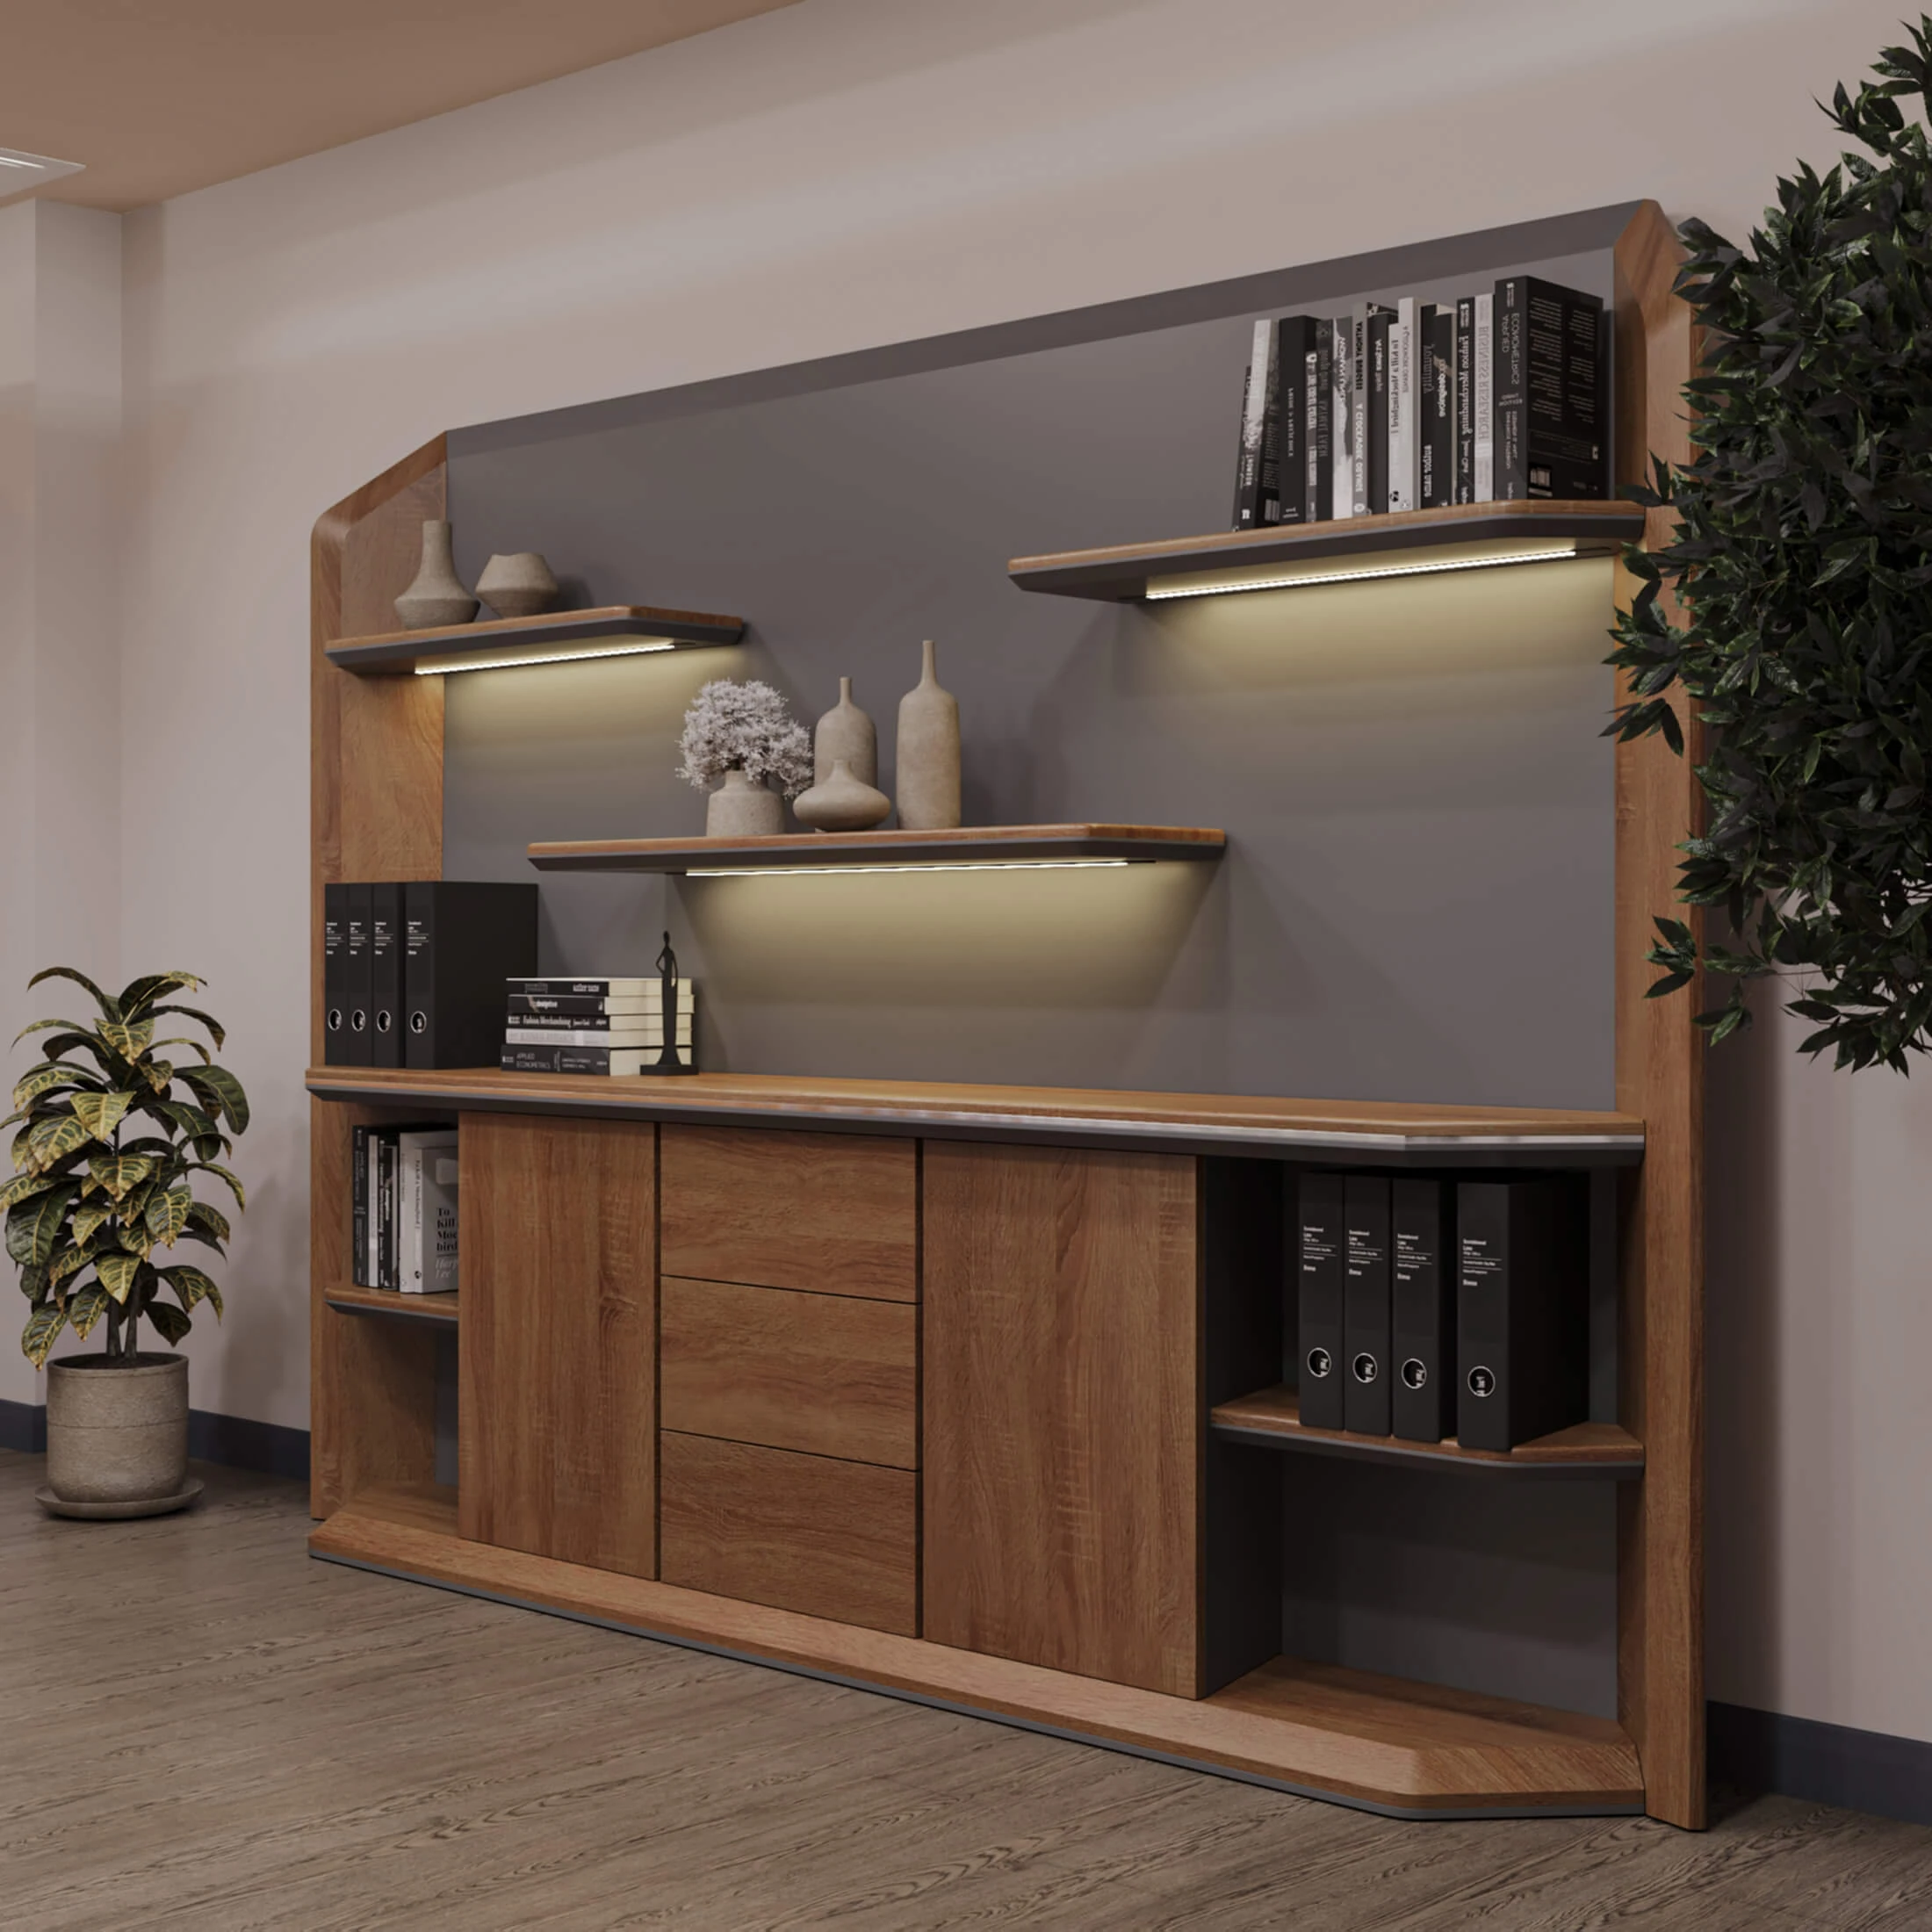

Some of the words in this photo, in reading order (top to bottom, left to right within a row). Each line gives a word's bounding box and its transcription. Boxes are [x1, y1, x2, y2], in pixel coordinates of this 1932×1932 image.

[436, 1208, 450, 1216] To
[436, 1218, 455, 1229] Kill
[436, 1241, 458, 1251] bird
